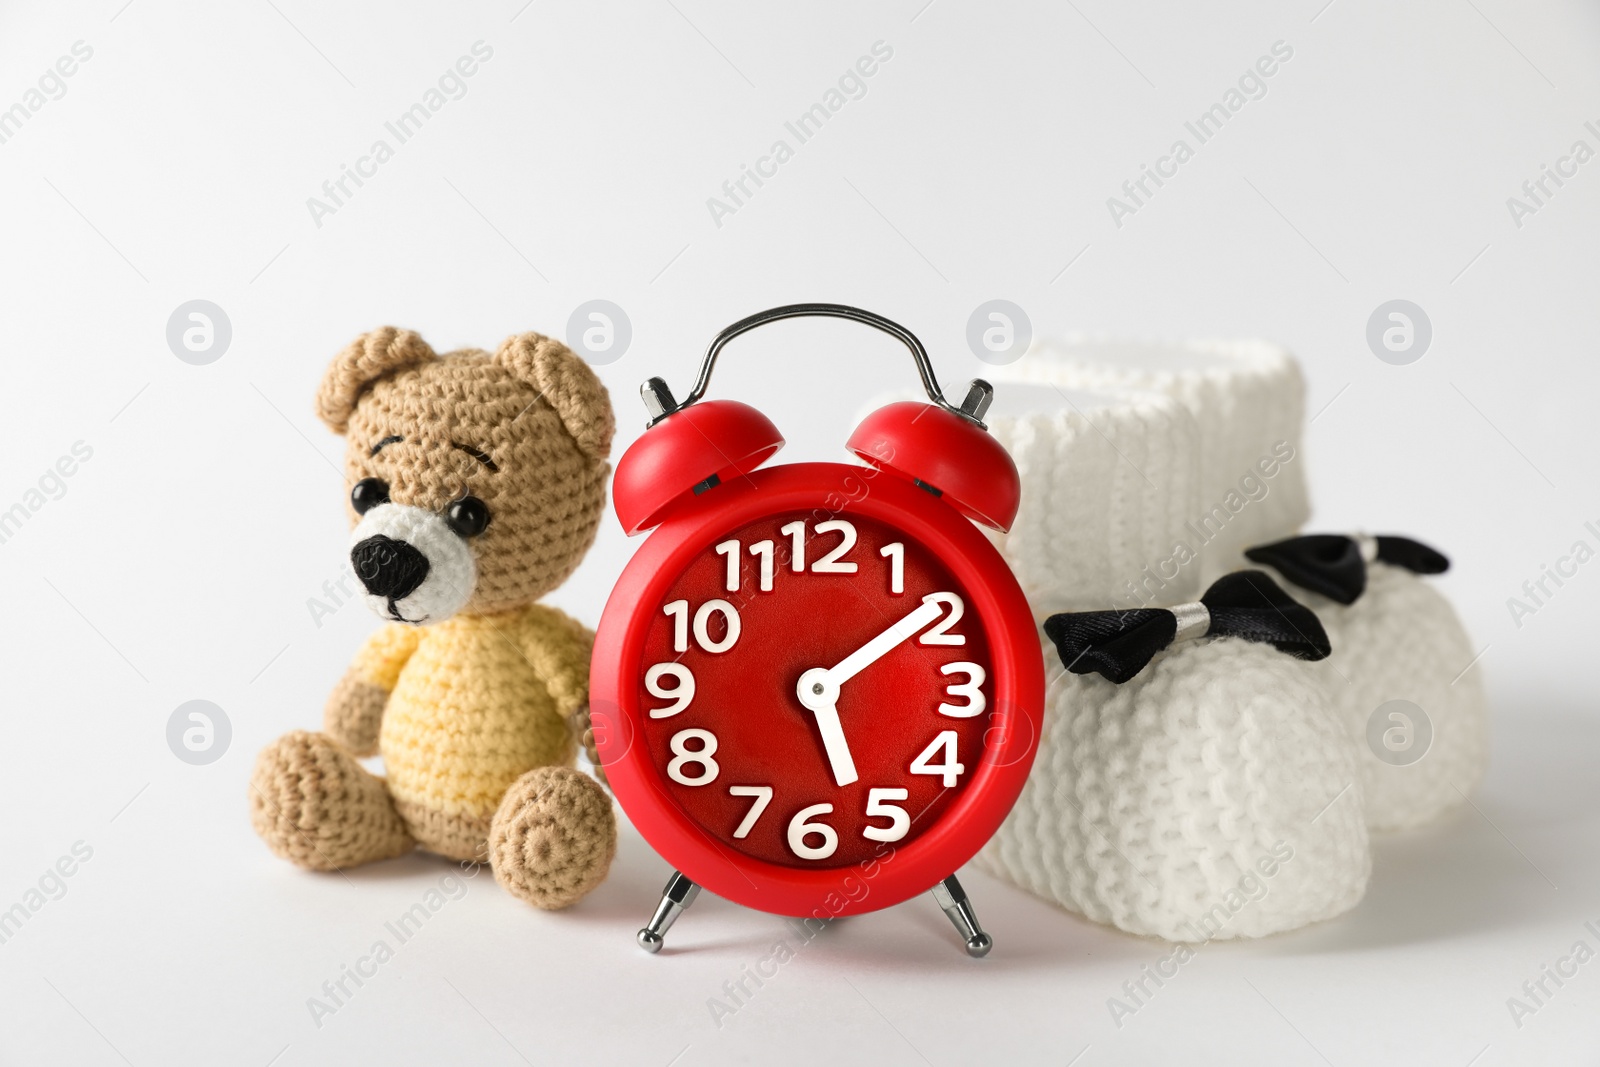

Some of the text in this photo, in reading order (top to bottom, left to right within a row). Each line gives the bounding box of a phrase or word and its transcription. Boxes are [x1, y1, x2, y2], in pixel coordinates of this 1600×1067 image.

[716, 540, 774, 592] 11
[781, 521, 857, 573] 12
[880, 543, 904, 593] 1
[664, 600, 740, 653] 10
[919, 591, 966, 646] 2
[645, 662, 695, 718] 9
[938, 662, 986, 717] 3
[667, 728, 719, 786] 8
[910, 730, 964, 787] 4
[729, 786, 773, 838] 7
[787, 803, 839, 859] 6
[863, 788, 911, 841] 5
